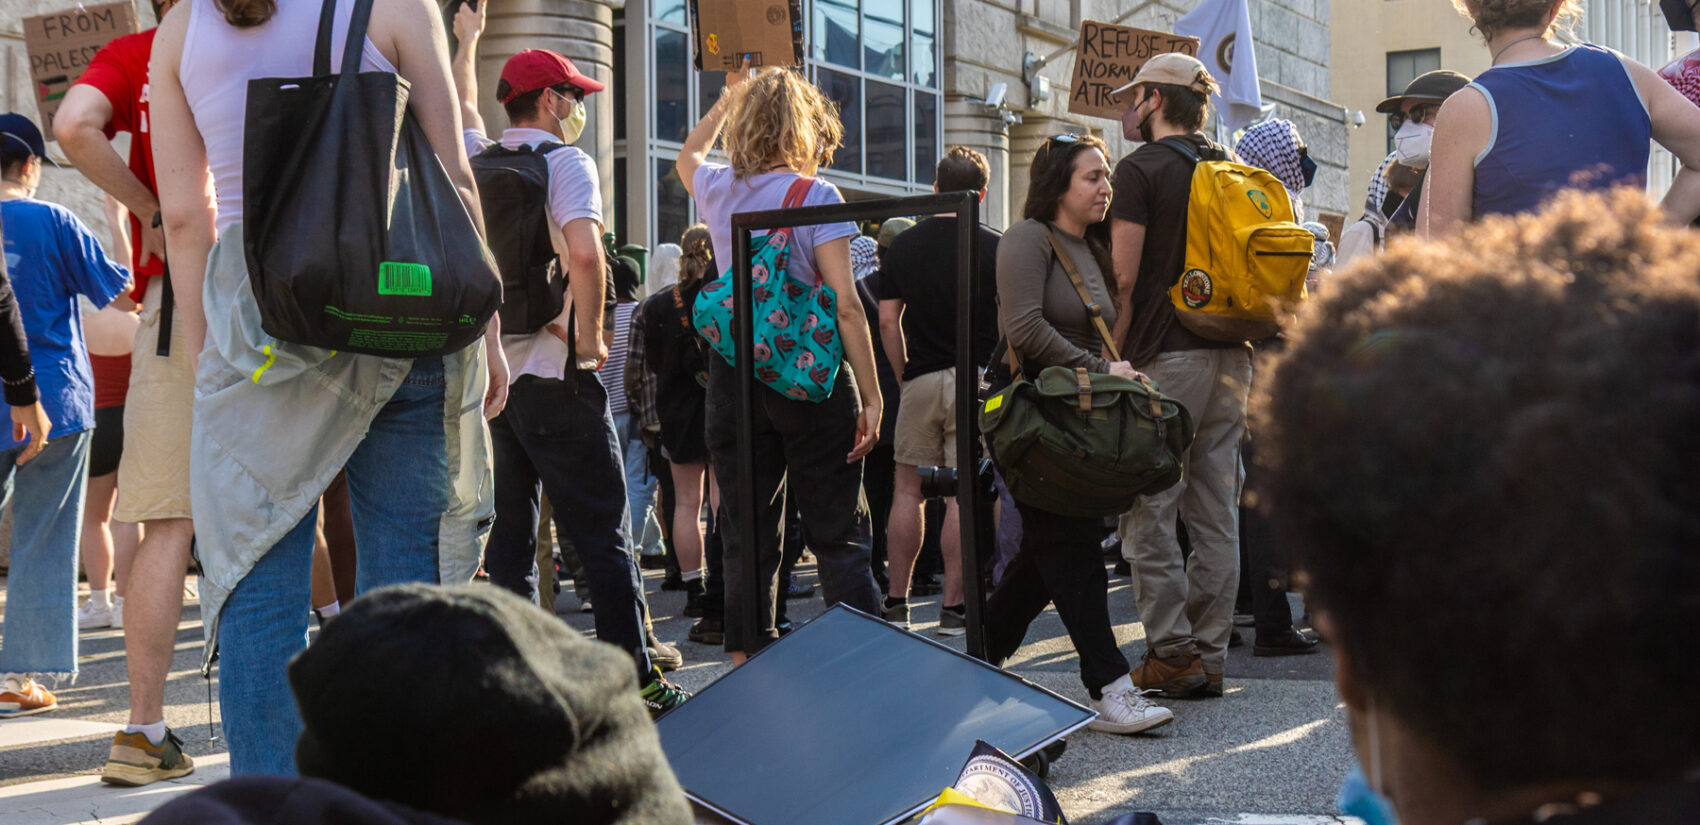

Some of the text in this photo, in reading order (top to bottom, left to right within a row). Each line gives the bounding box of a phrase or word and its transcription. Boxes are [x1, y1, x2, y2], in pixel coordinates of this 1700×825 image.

[42, 8, 116, 39] FROM
[1083, 23, 1195, 58] REFUSE TO
[1010, 777, 1021, 787] OF
